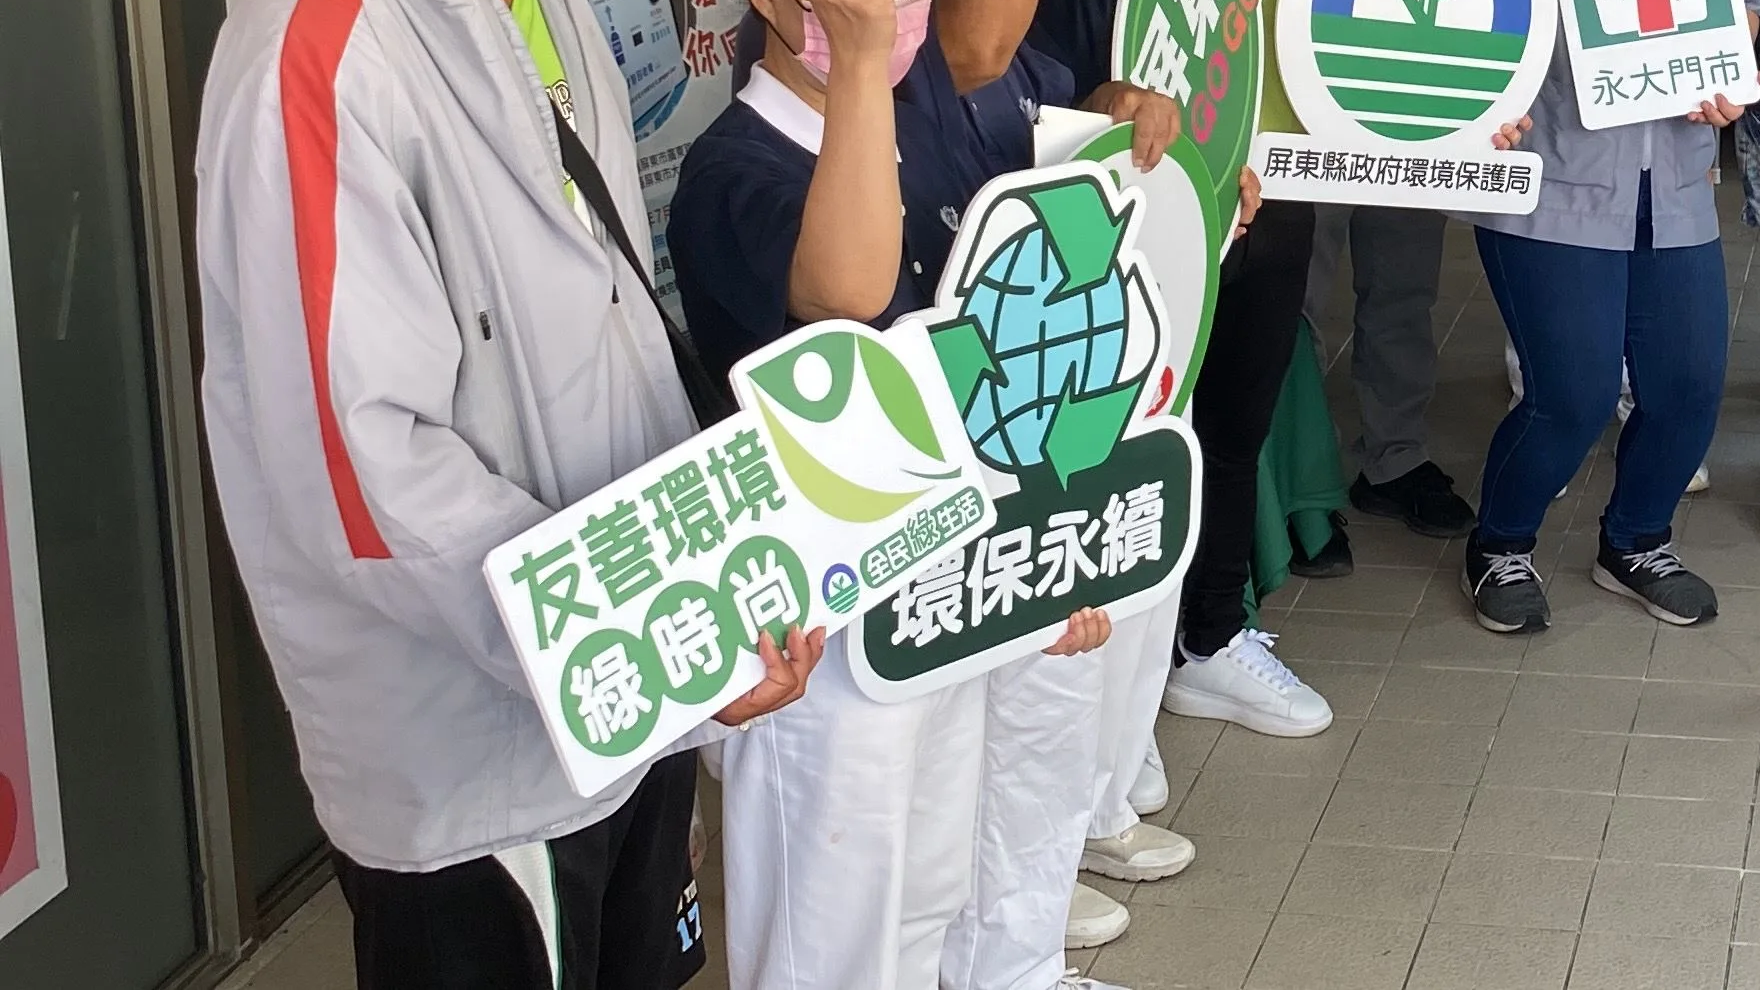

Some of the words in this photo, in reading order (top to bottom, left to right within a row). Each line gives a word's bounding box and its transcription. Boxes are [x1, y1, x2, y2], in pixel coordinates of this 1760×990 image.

[1592, 50, 1741, 108] 永大門市
[1264, 148, 1532, 197] 屏東縣政府環境保護局
[510, 428, 787, 650] 友善環境
[866, 491, 982, 587] 全民綠生活
[891, 480, 1164, 647] 環保永續
[570, 549, 801, 745] 綠時尚
